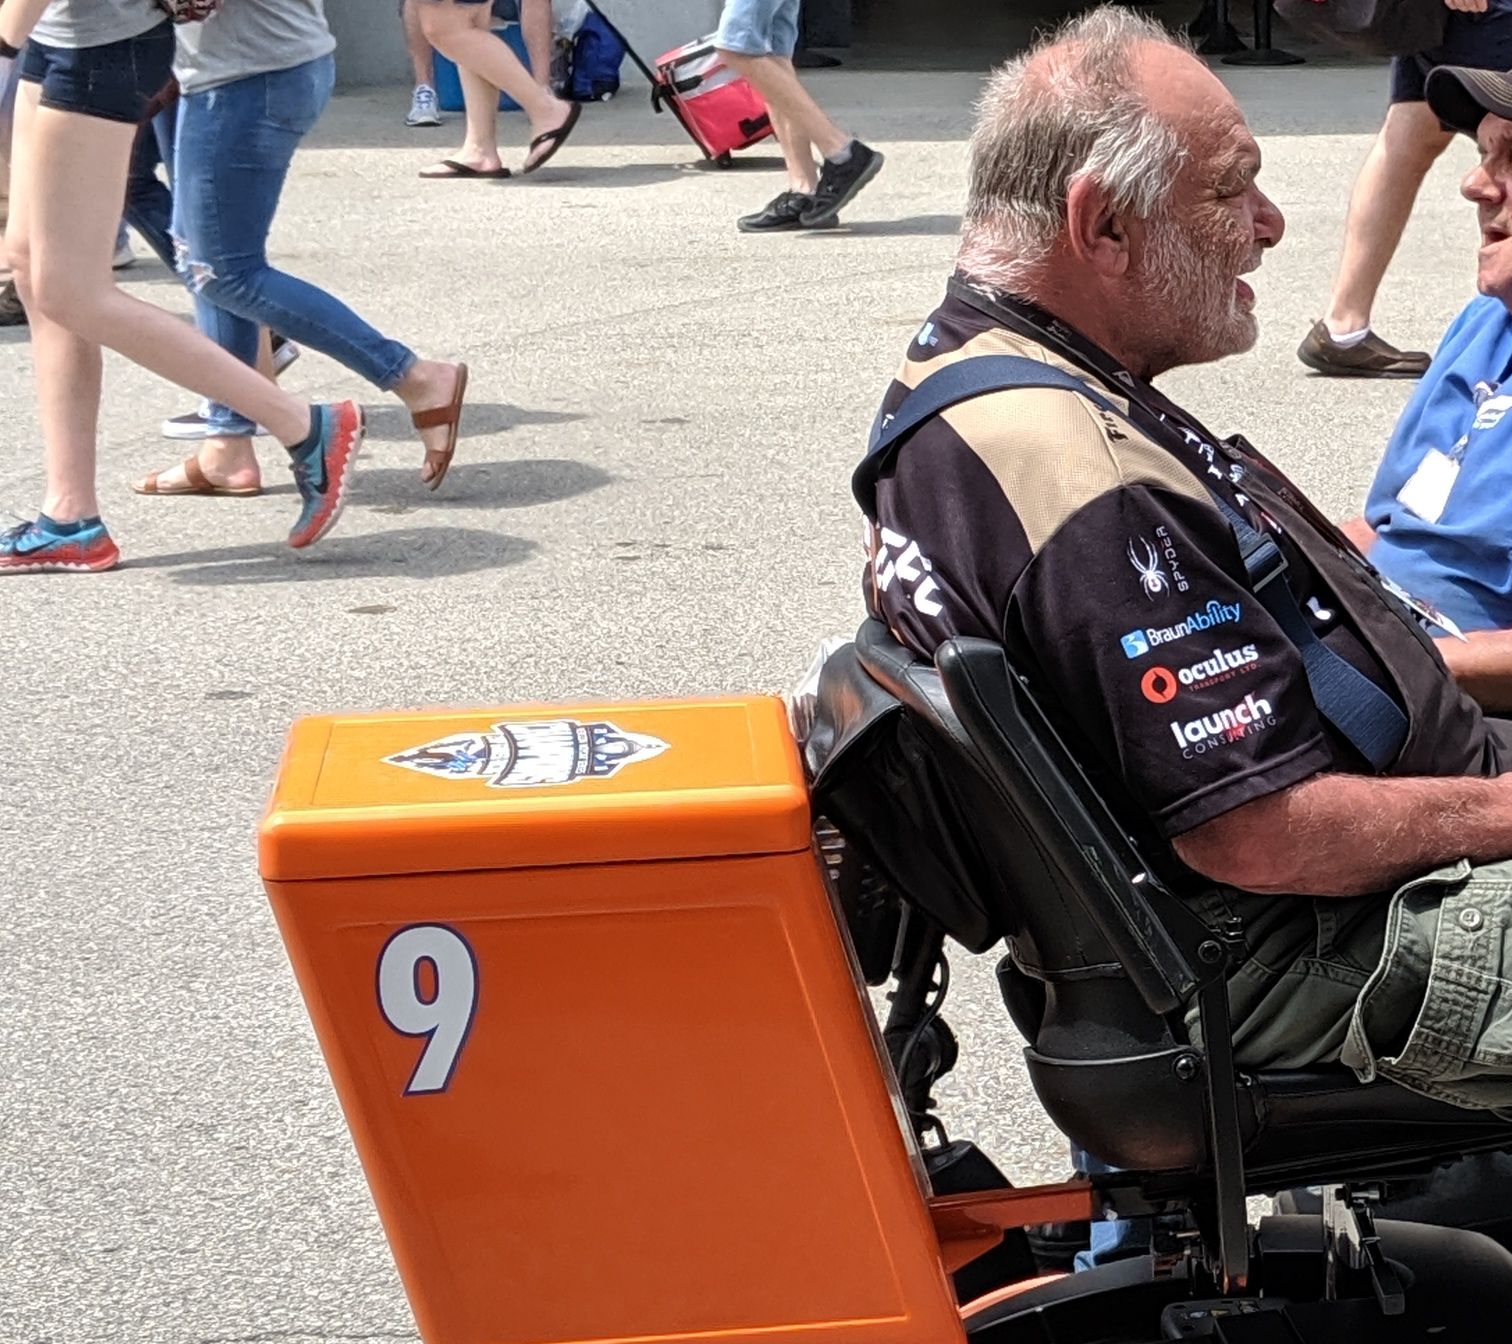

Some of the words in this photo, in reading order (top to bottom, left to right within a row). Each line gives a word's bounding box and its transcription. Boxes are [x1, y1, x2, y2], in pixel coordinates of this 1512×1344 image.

[1156, 525, 1189, 592] SPYDER
[1147, 600, 1241, 647] BraunAbility
[1178, 644, 1259, 685] oculus
[1170, 693, 1273, 749] launch
[375, 922, 481, 1098] 9
